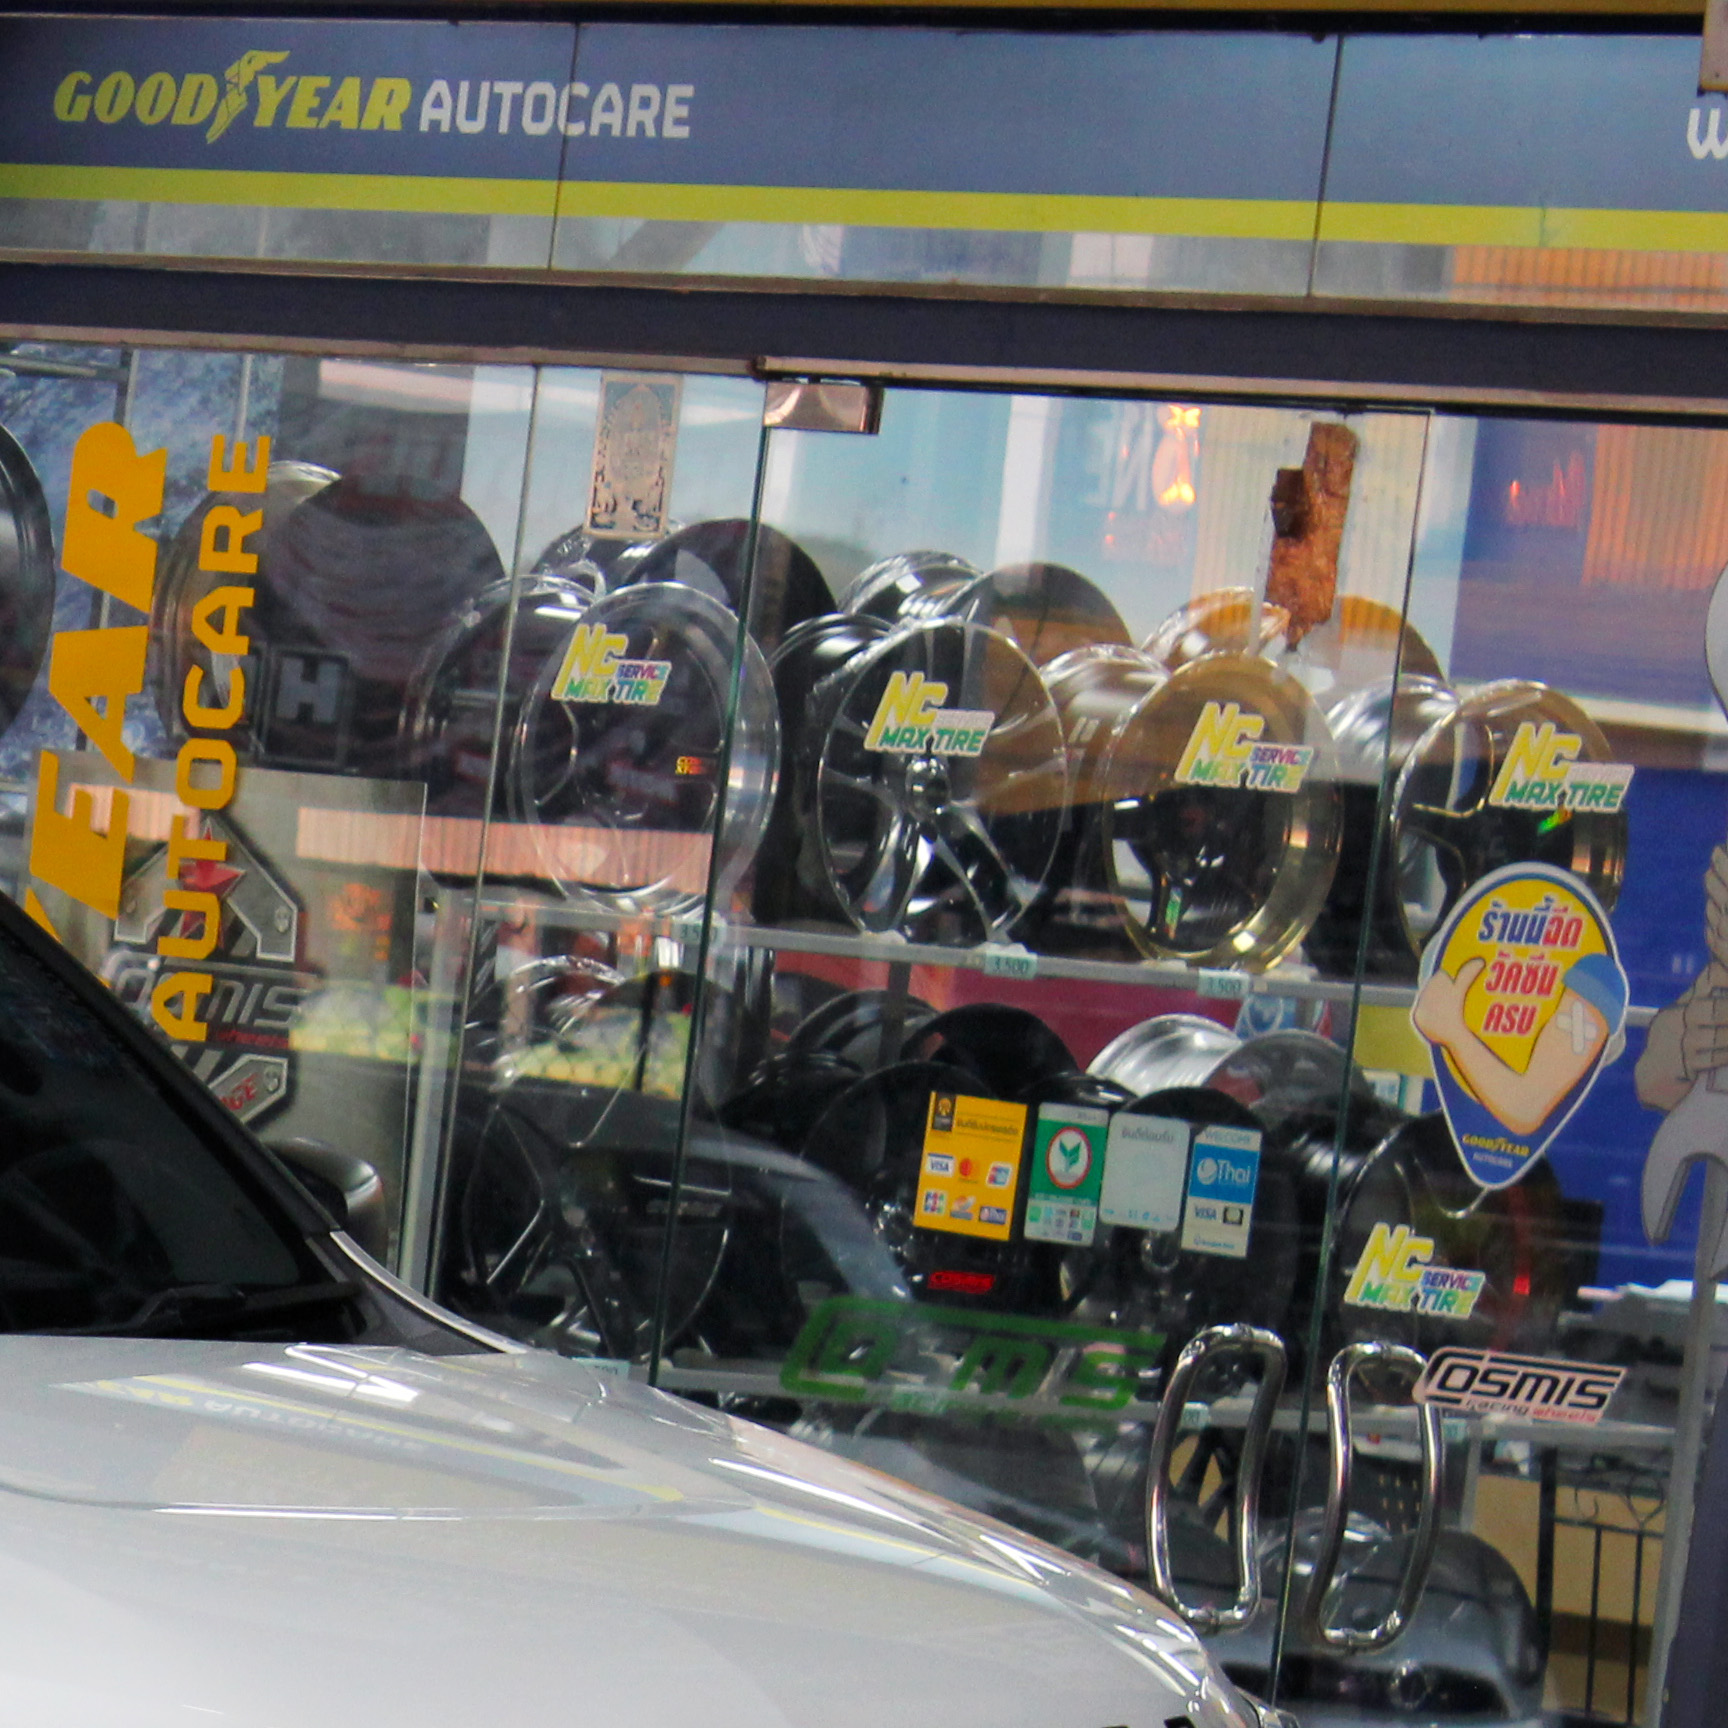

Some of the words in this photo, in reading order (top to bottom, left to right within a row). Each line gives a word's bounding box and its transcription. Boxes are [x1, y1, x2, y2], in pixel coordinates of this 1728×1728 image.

[53, 58, 411, 139] GOODYEAR
[419, 79, 695, 139] AUTOCARE
[553, 624, 628, 699] NC
[151, 434, 271, 1042] AUTOCARE
[865, 672, 948, 748] NC
[879, 726, 930, 749] MAX
[934, 728, 986, 752] TIRE
[1176, 702, 1264, 776] NC
[1491, 722, 1582, 800] NC
[1505, 780, 1562, 804] MAX
[1565, 783, 1624, 808] TIRE
[1485, 951, 1559, 997] วัคซีน
[1483, 1002, 1537, 1036] ครบ
[1462, 1134, 1529, 1156] GOODYEAR
[1346, 1223, 1434, 1297] NC
[1425, 1350, 1626, 1410] COSMIS
